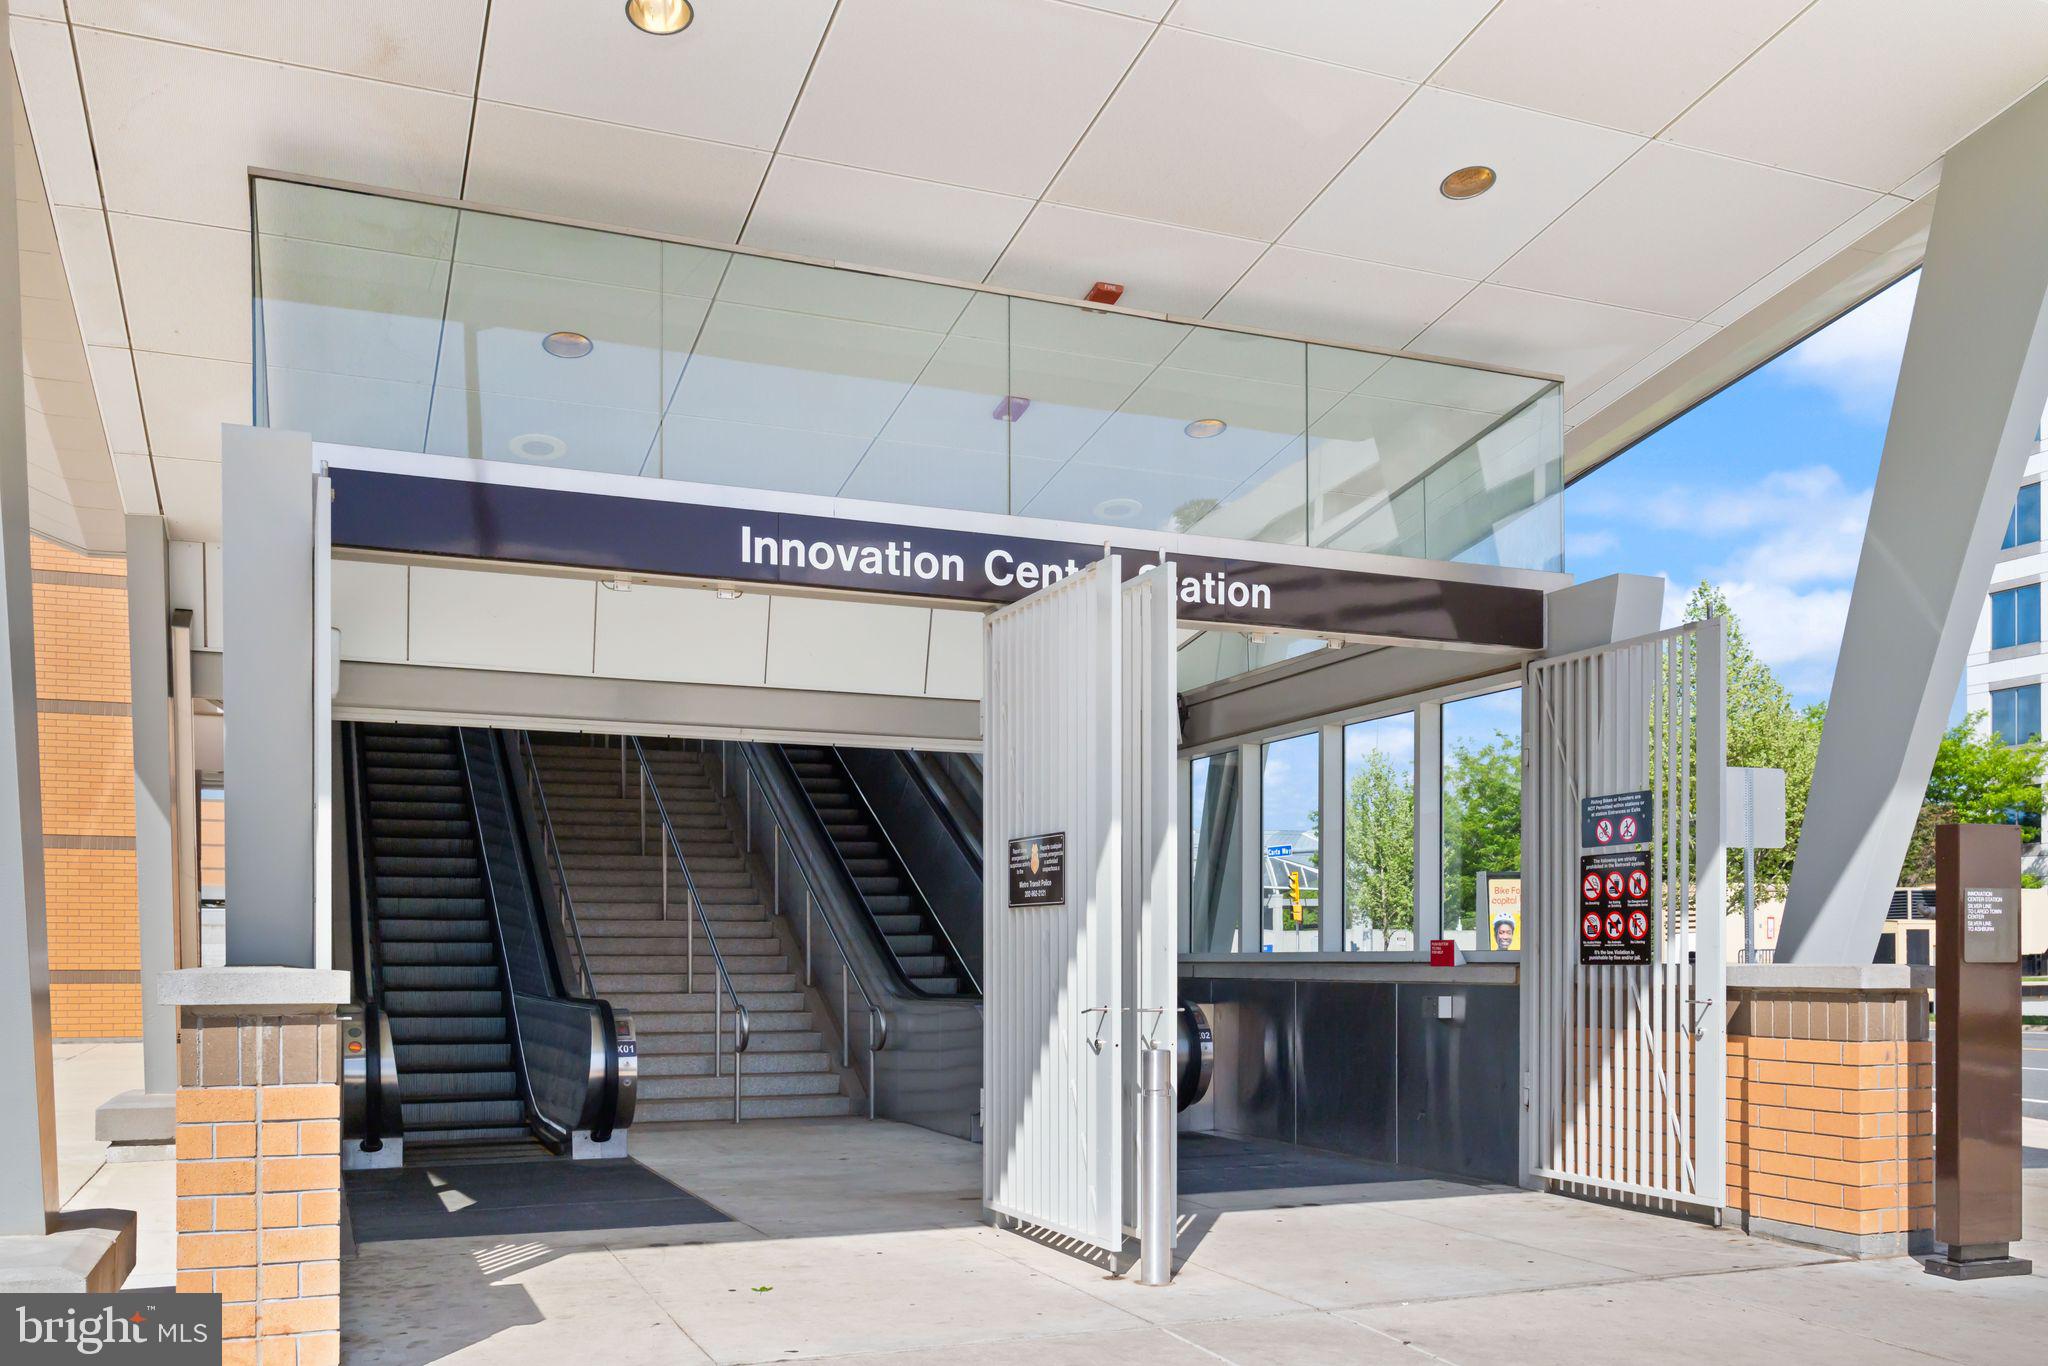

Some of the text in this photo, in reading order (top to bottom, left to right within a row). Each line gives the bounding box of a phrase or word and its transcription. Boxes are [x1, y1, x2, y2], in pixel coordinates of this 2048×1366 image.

[741, 526, 964, 581] Innovation
[984, 549, 1079, 589] Cent
[1495, 887, 1510, 895] Bike
[1492, 897, 1517, 906] capital
